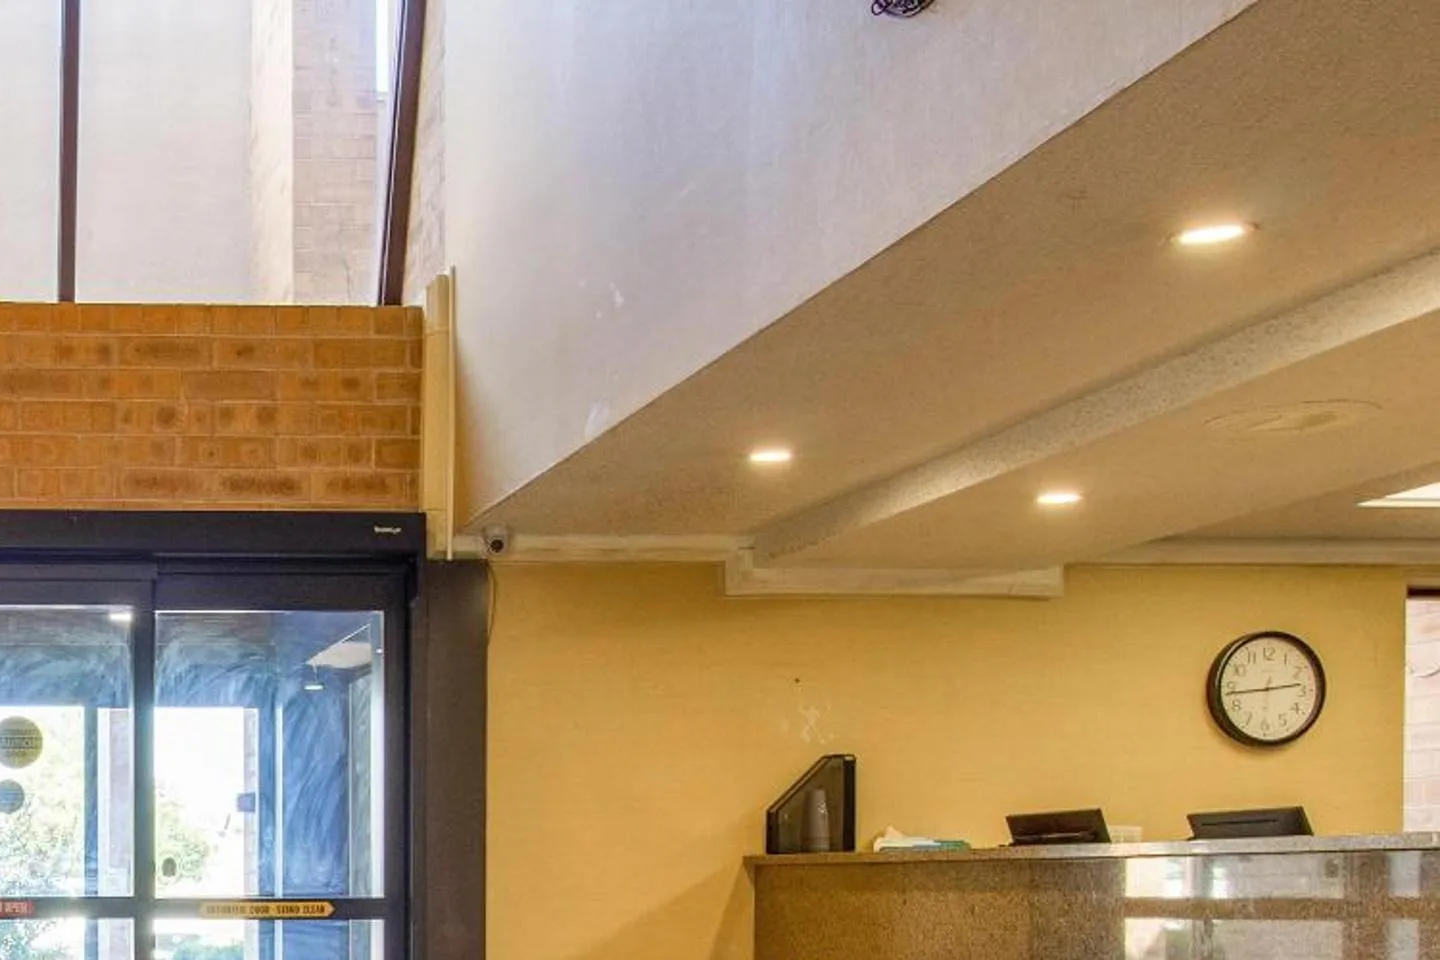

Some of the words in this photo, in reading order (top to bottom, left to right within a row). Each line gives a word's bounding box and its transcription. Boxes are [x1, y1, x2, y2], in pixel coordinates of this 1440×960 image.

[1247, 651, 1257, 664] 11
[1262, 647, 1276, 661] 12
[1234, 664, 1246, 677] 10
[1292, 666, 1302, 679] 2
[1297, 684, 1306, 697] 3
[1290, 702, 1302, 714] 4
[1244, 712, 1253, 726] 7
[1260, 717, 1270, 731] 6
[1278, 713, 1288, 727] 5
